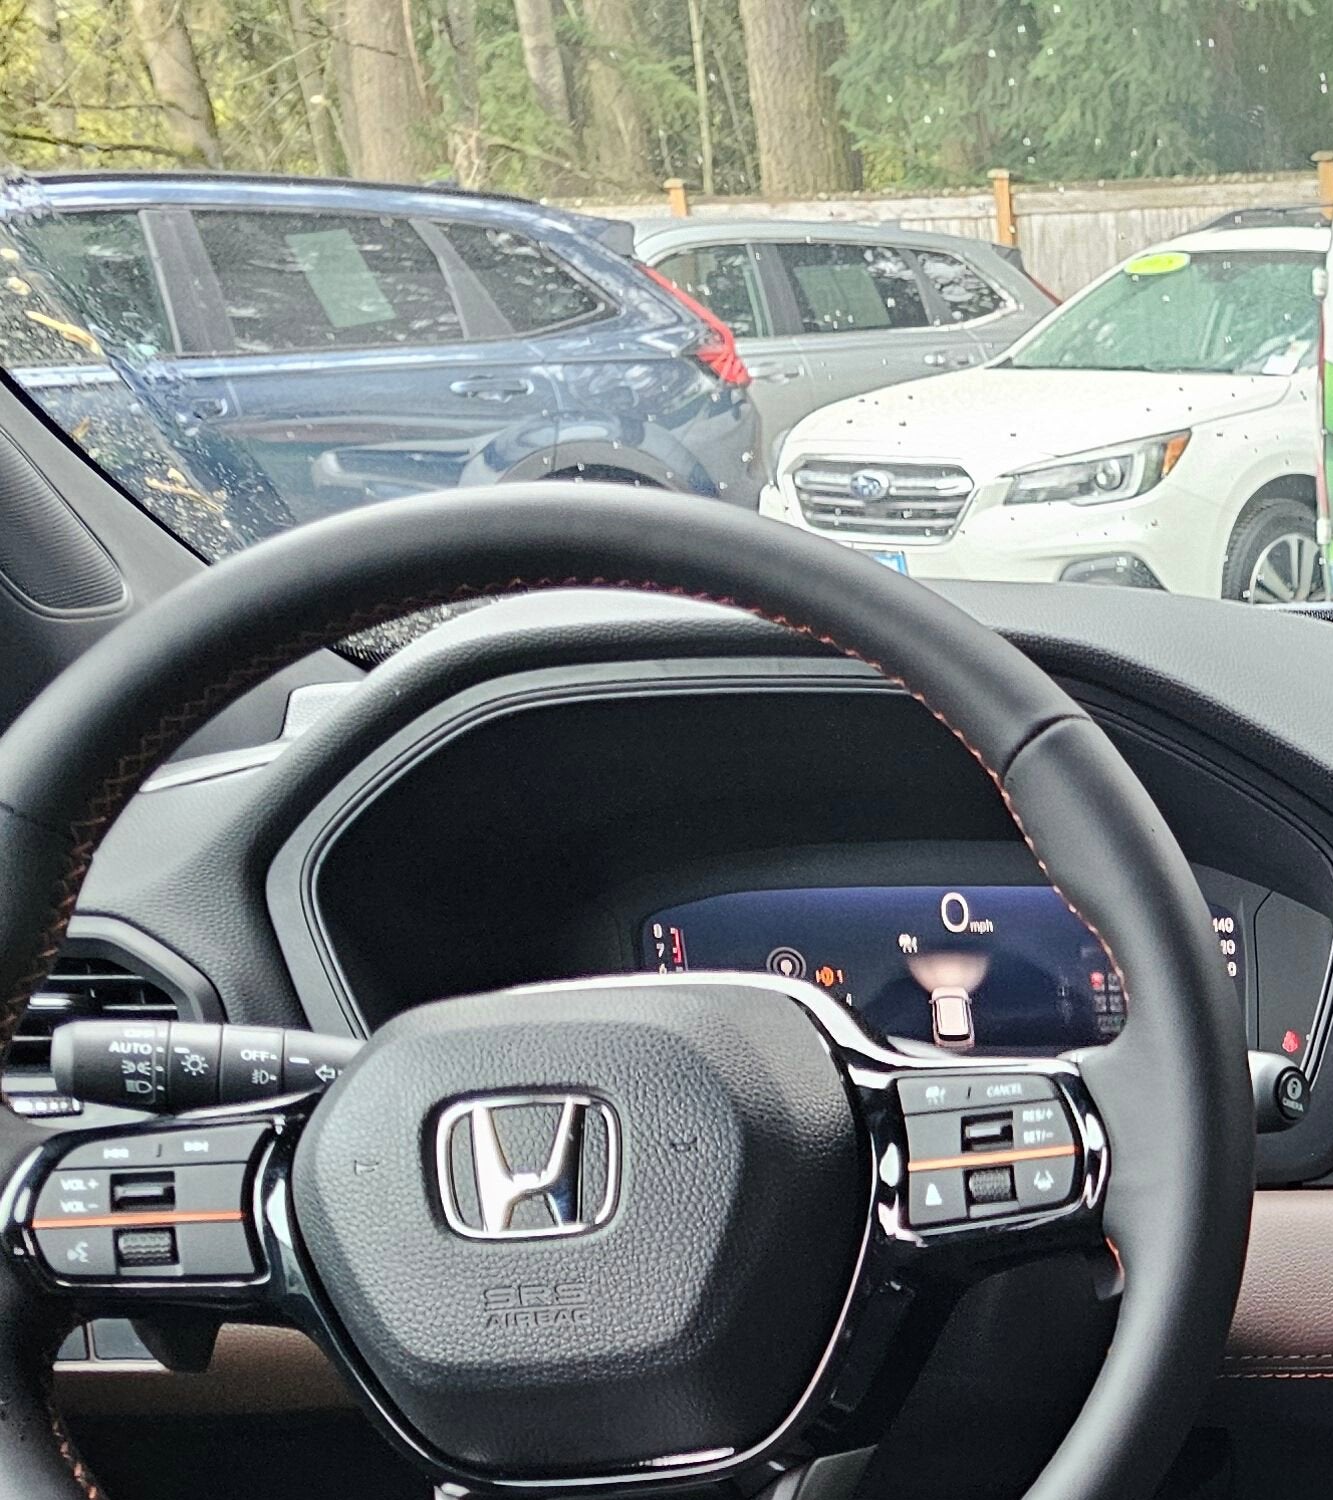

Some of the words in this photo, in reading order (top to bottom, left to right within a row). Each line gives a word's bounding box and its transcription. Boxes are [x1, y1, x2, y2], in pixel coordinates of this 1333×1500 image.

[940, 891, 969, 933] 0
[970, 919, 994, 935] mph
[1212, 917, 1234, 933] 140
[108, 1041, 152, 1054] AUTO
[240, 1049, 270, 1062] OFF
[987, 1083, 1023, 1097] CANCEL
